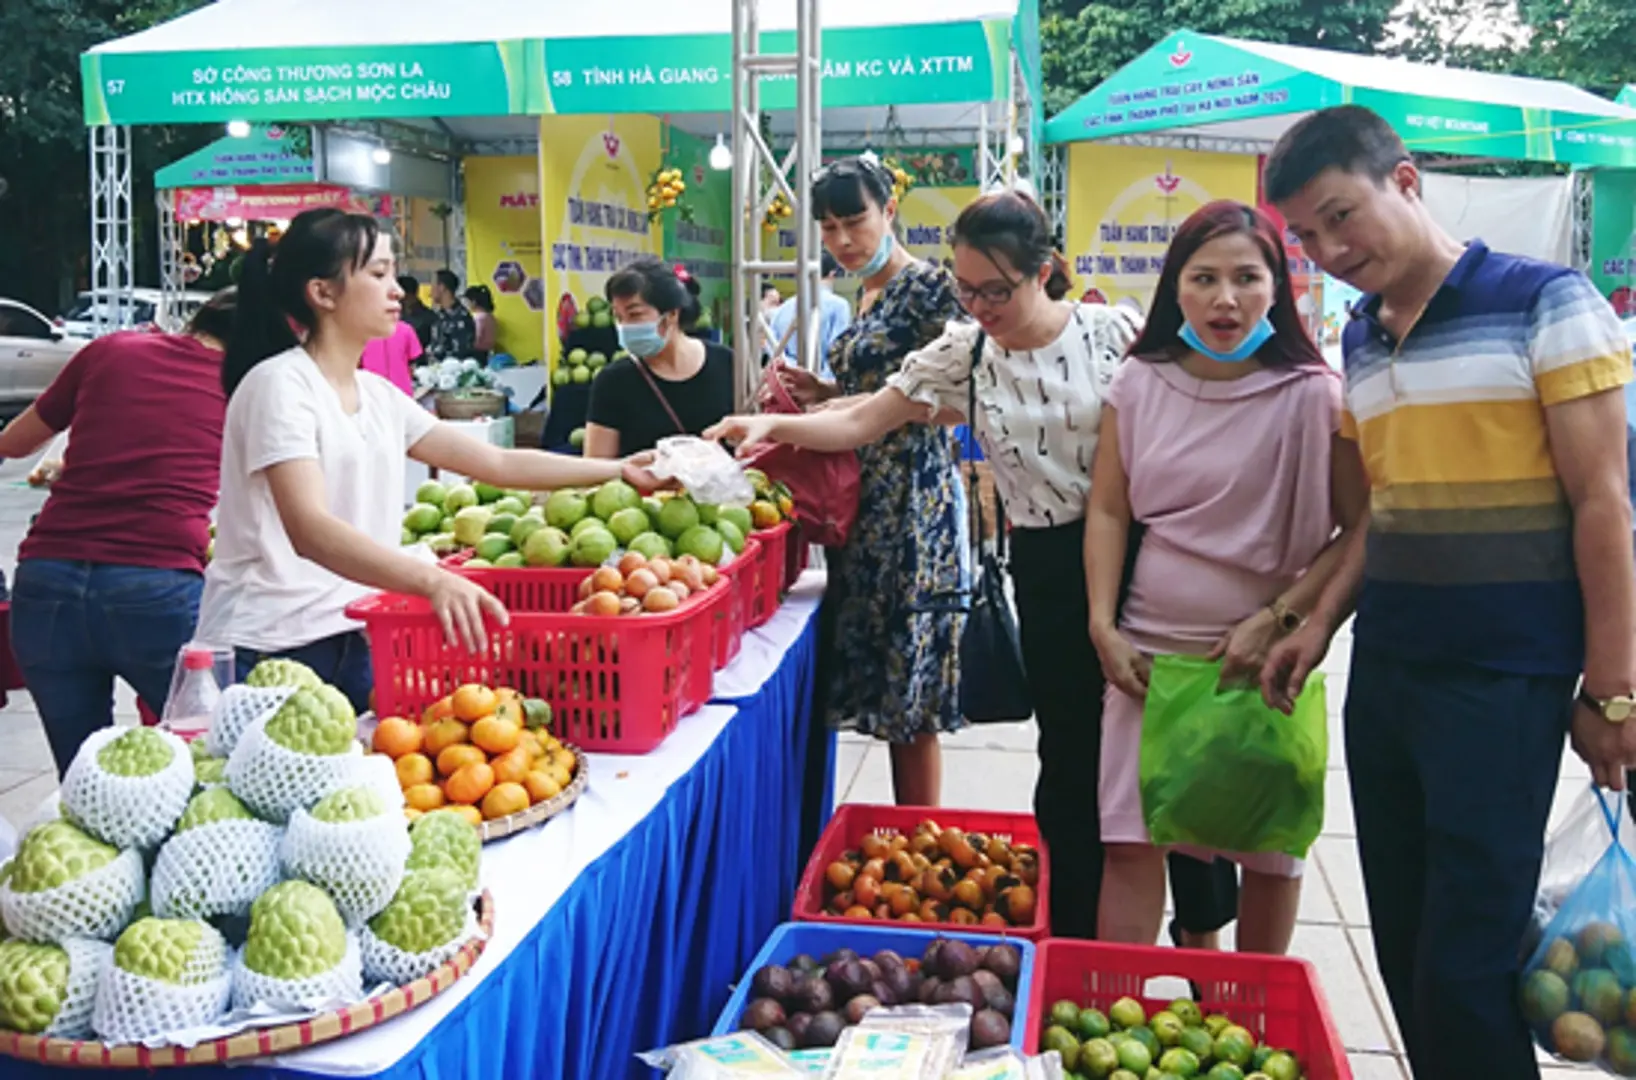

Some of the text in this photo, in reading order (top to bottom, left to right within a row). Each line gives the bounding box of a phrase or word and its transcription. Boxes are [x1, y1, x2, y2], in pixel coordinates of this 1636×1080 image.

[193, 62, 424, 84] SỞ CÔNG THƯƠNG SƠN LA
[552, 69, 572, 86] 58
[582, 65, 624, 85] TỈNH
[629, 64, 655, 84] HÀ
[659, 67, 718, 84] GIANG
[821, 59, 851, 79] ÂM
[856, 61, 882, 77] KC
[888, 56, 915, 75] VÀ
[920, 56, 973, 74] XTTM
[107, 79, 126, 95] 57
[172, 80, 451, 106] HTX NÔNG SẢN SẠCH MỘC CHÂU
